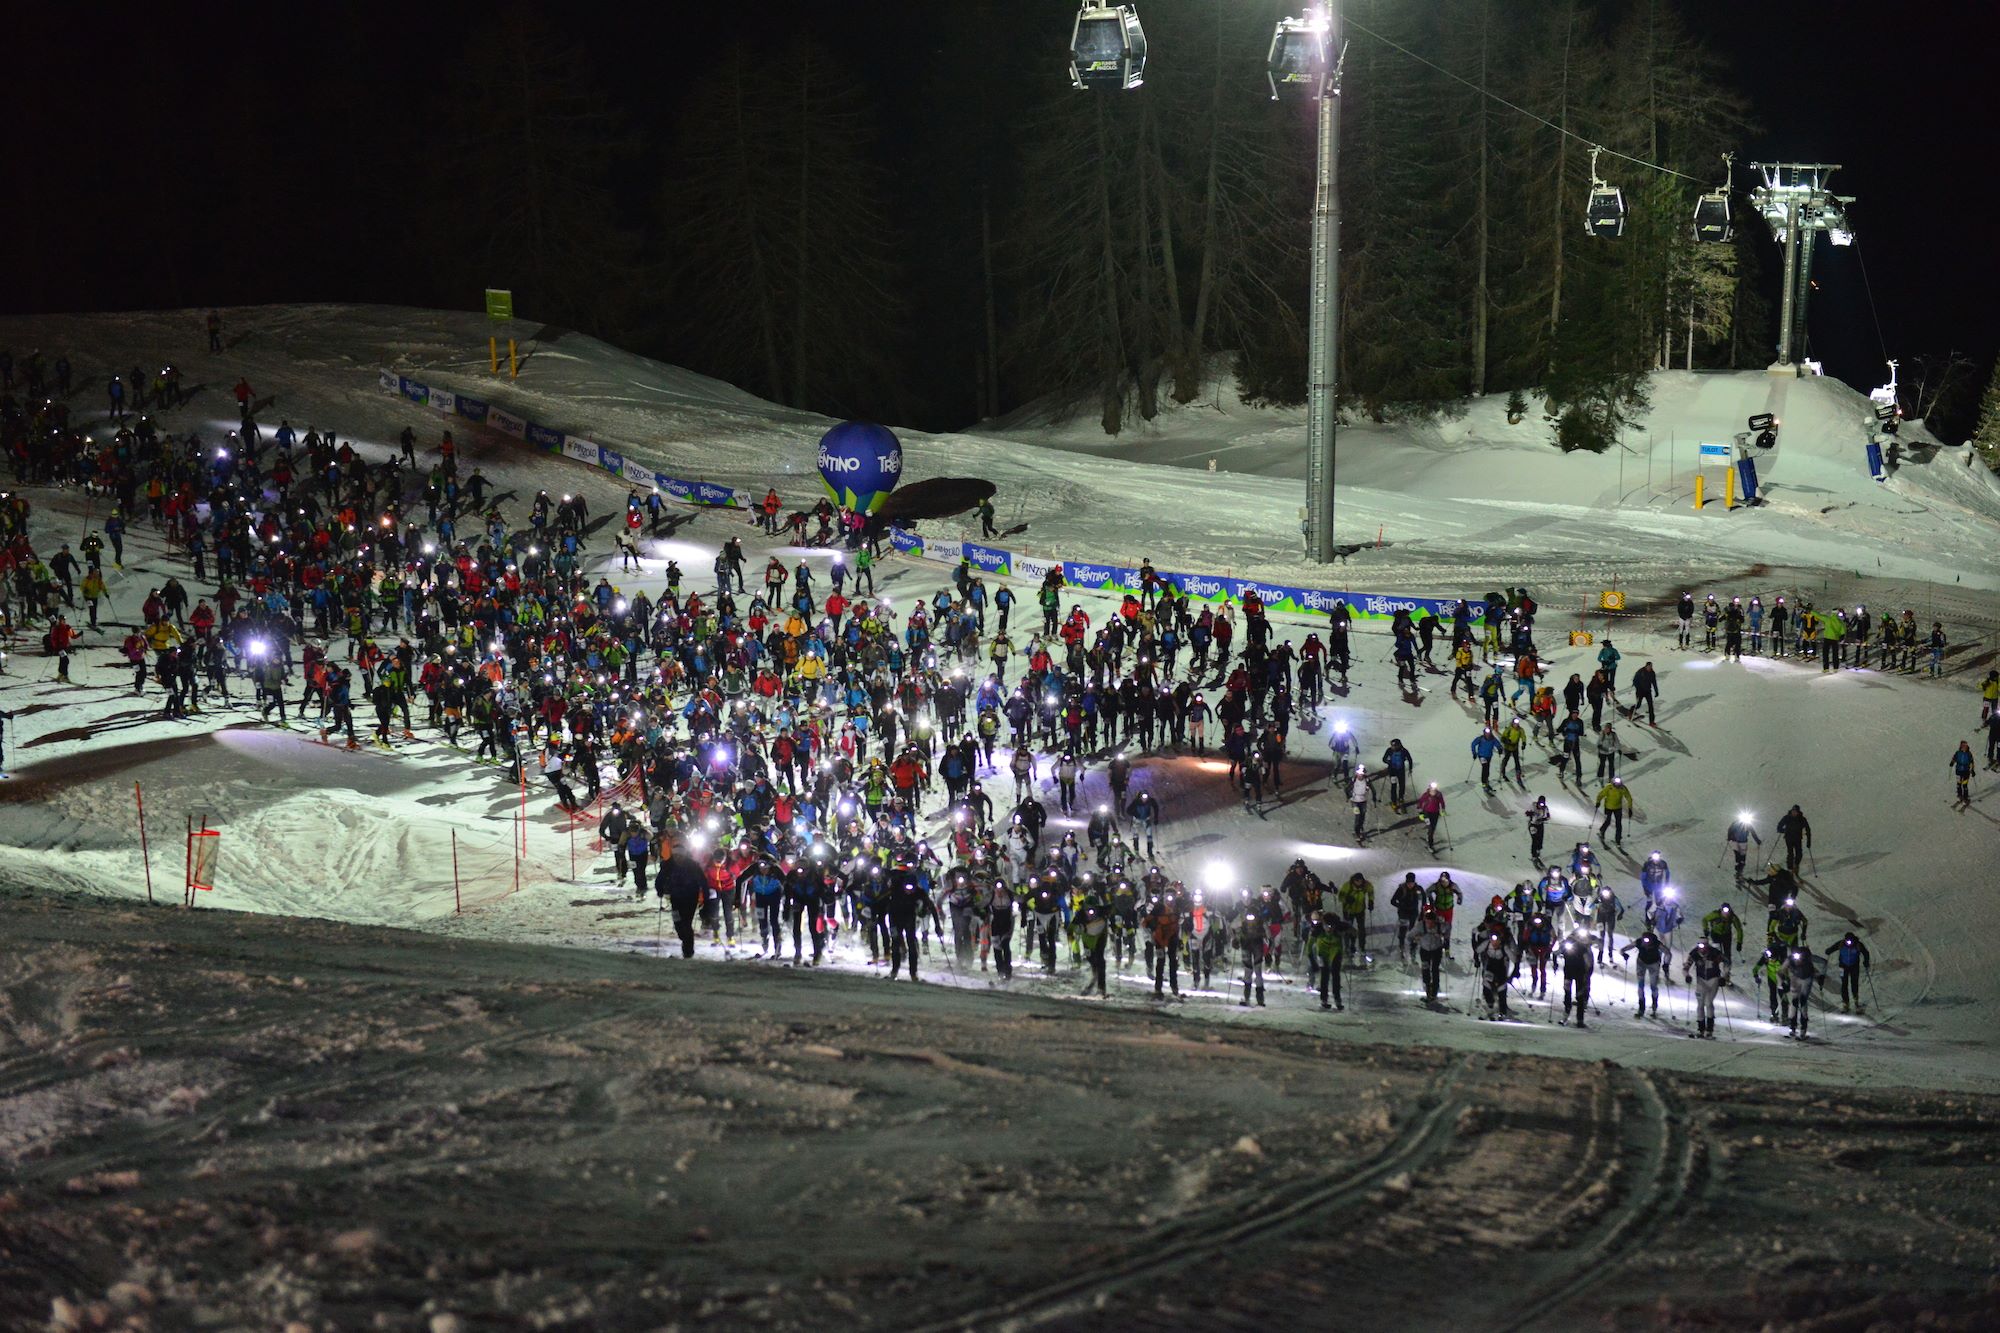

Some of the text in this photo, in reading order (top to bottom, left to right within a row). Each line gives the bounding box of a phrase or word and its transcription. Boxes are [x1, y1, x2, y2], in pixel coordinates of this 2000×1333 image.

[971, 548, 1004, 565] TRENTINO
[1073, 566, 1110, 583] TRENTINO
[1183, 576, 1220, 595] TRENTINO
[1365, 596, 1416, 614] TRENTINO
